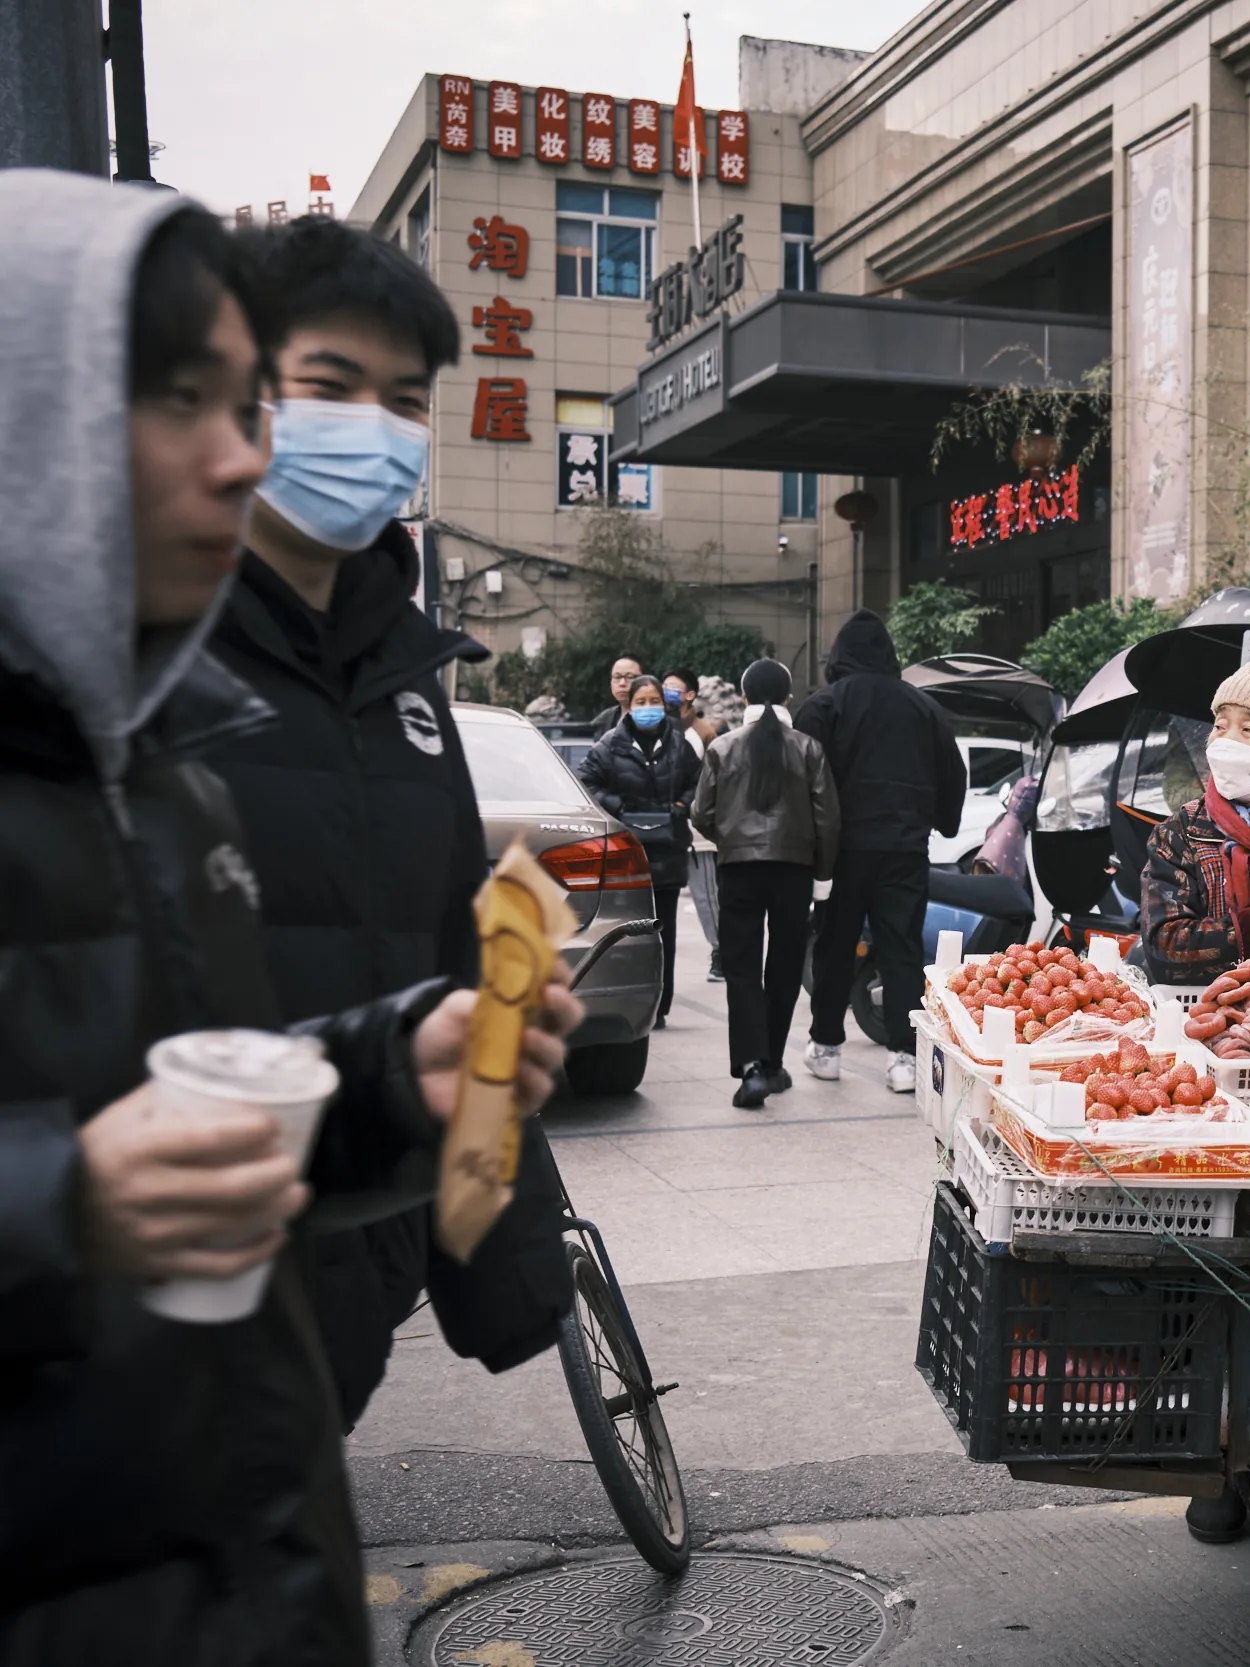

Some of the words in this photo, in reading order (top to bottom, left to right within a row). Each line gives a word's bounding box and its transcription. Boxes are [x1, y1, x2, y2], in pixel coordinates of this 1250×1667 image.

[493, 86, 518, 153] 美甲
[541, 92, 566, 159] 化妆
[586, 99, 612, 164] 纹绣
[633, 104, 657, 170] 美容
[721, 116, 746, 179] 学校
[467, 215, 534, 442] 淘宝屋
[1173, 1152, 1250, 1166] 精品水果
